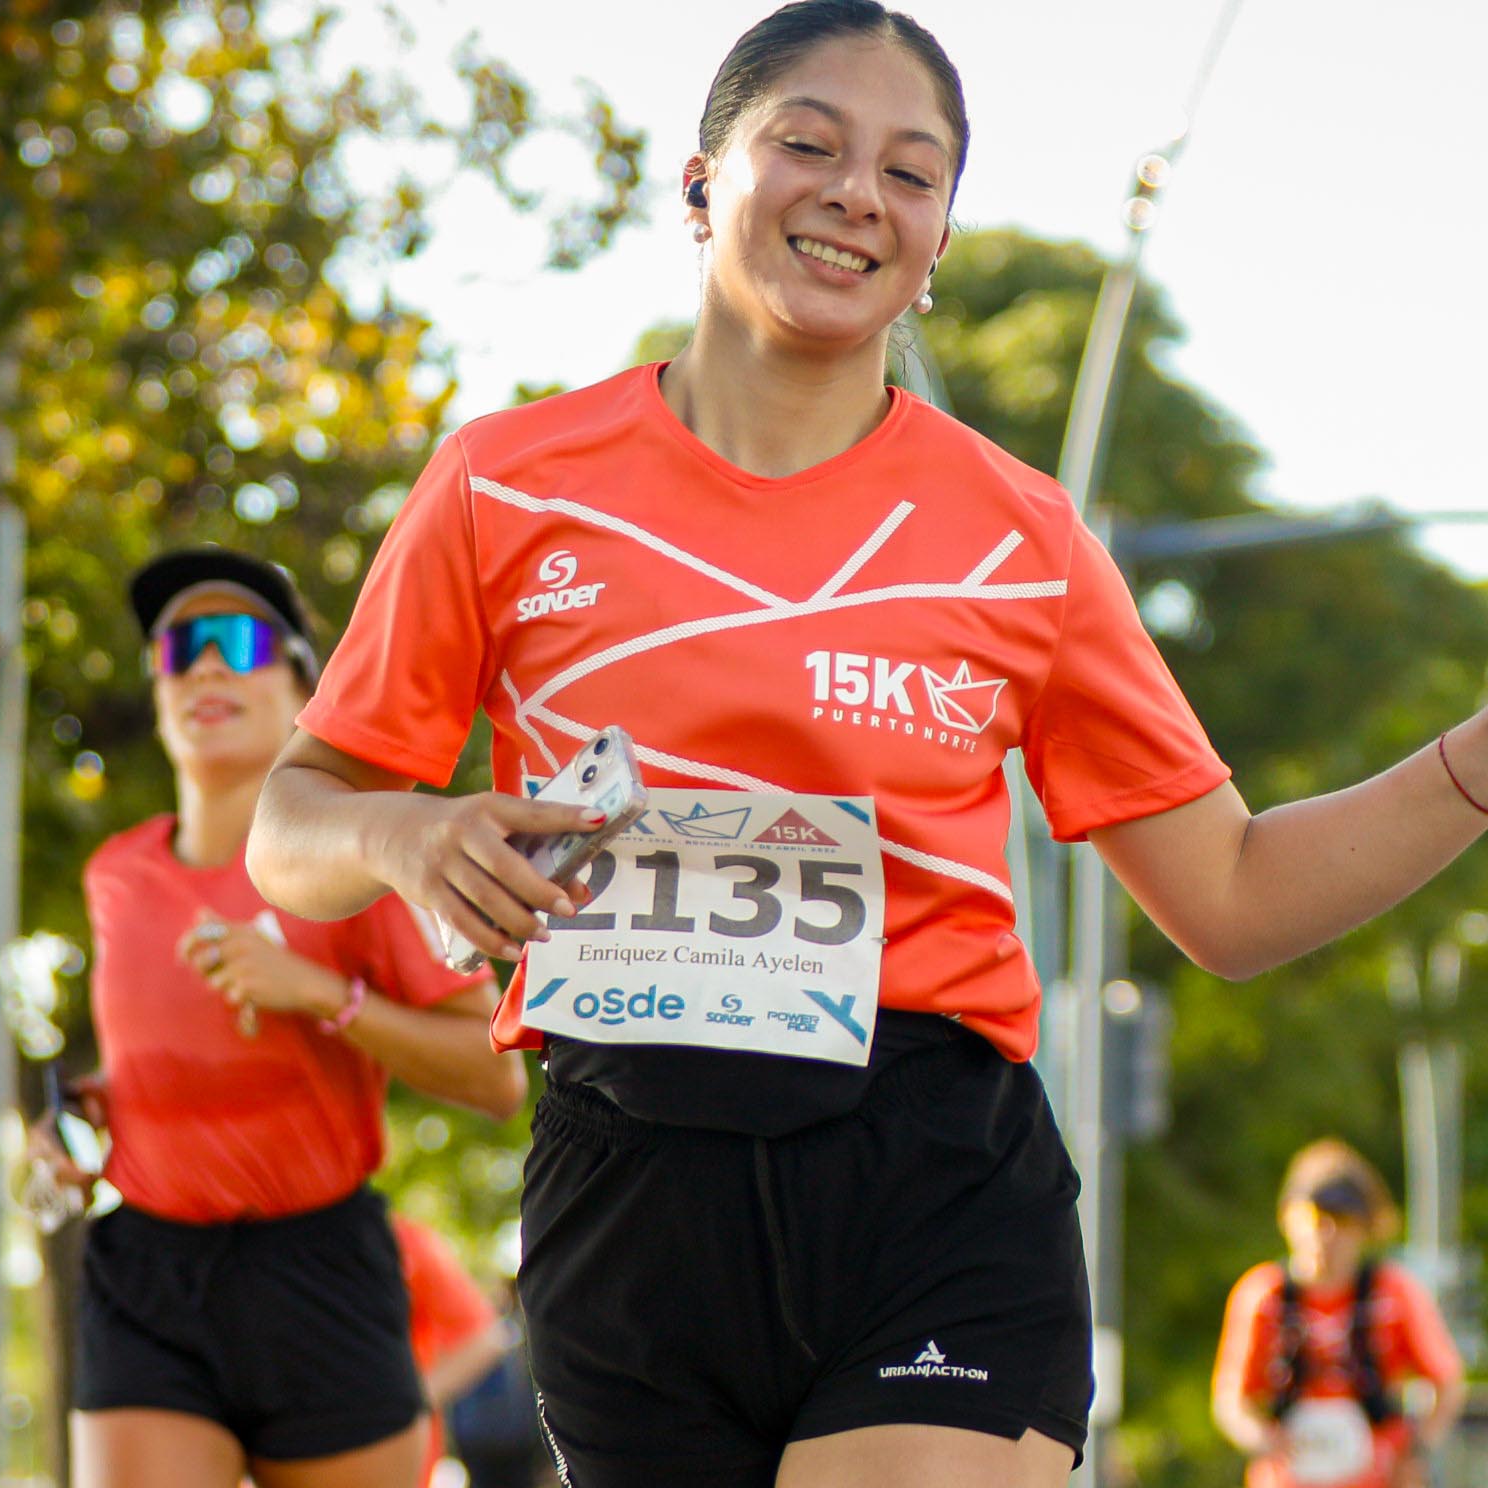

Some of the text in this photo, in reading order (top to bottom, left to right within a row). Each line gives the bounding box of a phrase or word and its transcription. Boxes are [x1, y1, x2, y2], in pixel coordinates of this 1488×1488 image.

[805, 650, 917, 716] 15K
[813, 706, 977, 753] PUERTO NORTE
[771, 825, 819, 841] 15K
[546, 849, 867, 946] 2135
[577, 943, 824, 975] Enriquez Camila Ayelen
[572, 983, 686, 1021] osde
[767, 1010, 820, 1024] POWER
